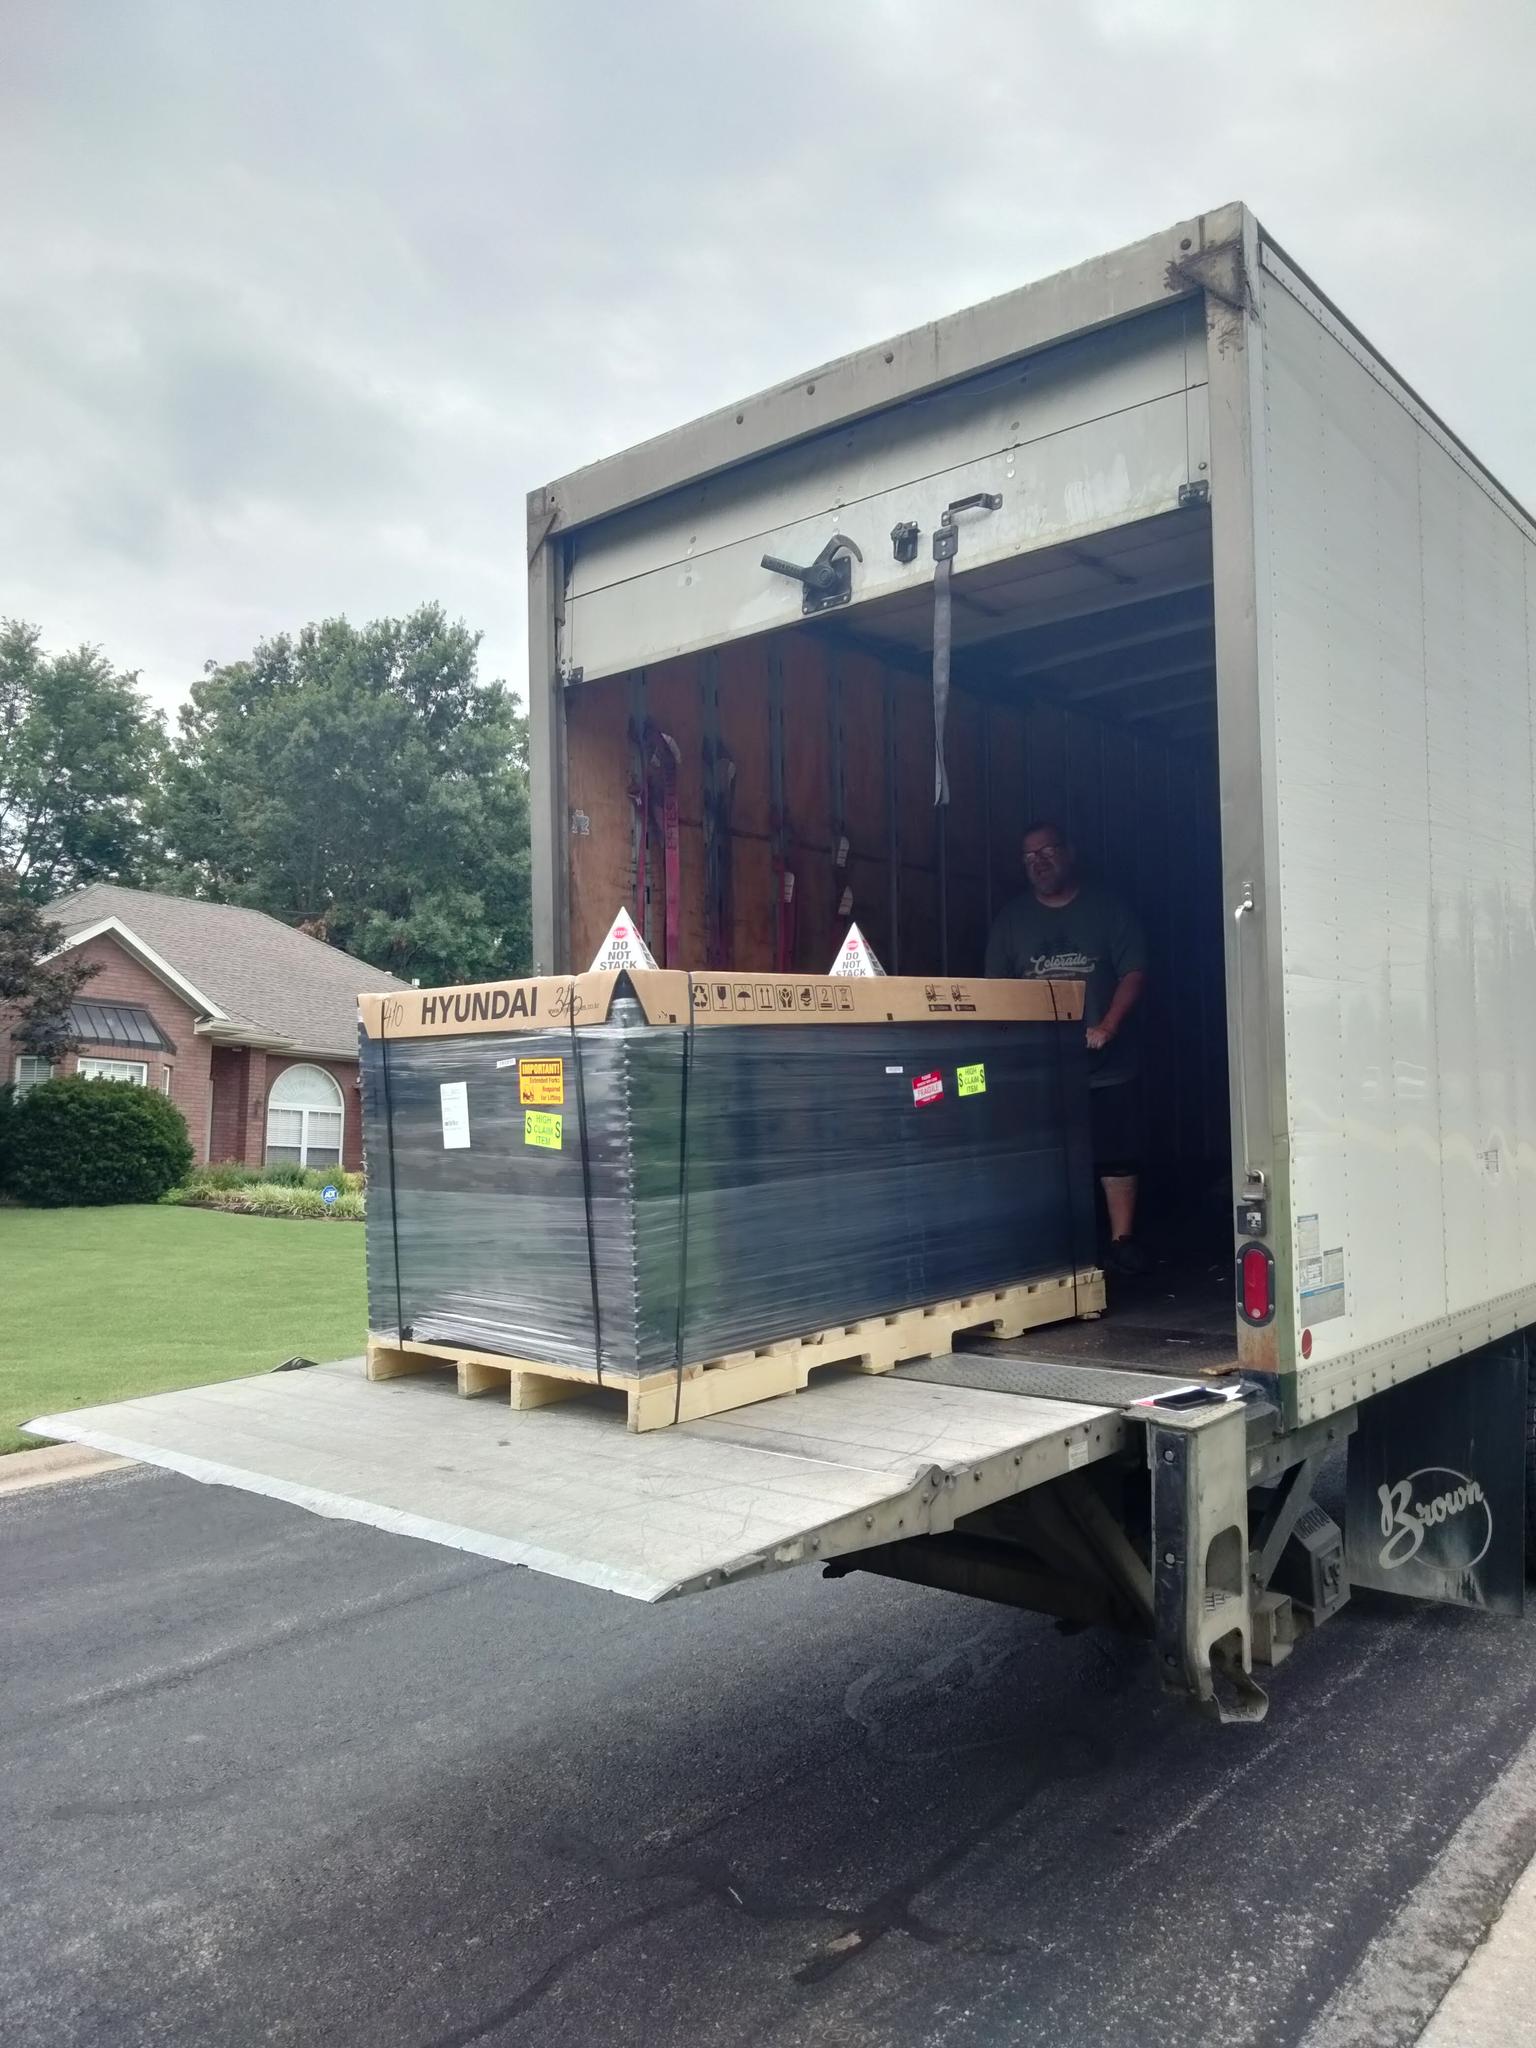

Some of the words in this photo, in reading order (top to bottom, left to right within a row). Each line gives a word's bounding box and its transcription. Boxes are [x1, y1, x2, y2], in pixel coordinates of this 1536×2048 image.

[612, 941, 628, 950] DO
[608, 951, 631, 960] NOT
[846, 952, 859, 960] DO
[600, 961, 637, 971] STACK
[842, 960, 860, 969] NOT
[1030, 953, 1090, 974] Colorado
[421, 986, 538, 1025] HYUNDAI
[522, 1063, 560, 1075] IMPORTANT!
[964, 1067, 977, 1076] HIGH
[964, 1076, 979, 1085] CLAIM
[917, 1083, 940, 1098] FRAGILE
[966, 1085, 978, 1093] ITEM
[535, 1114, 552, 1124] HIGH
[533, 1125, 553, 1135] CLAIM
[535, 1136, 551, 1145] ITEM
[1378, 1480, 1484, 1570] Brown
